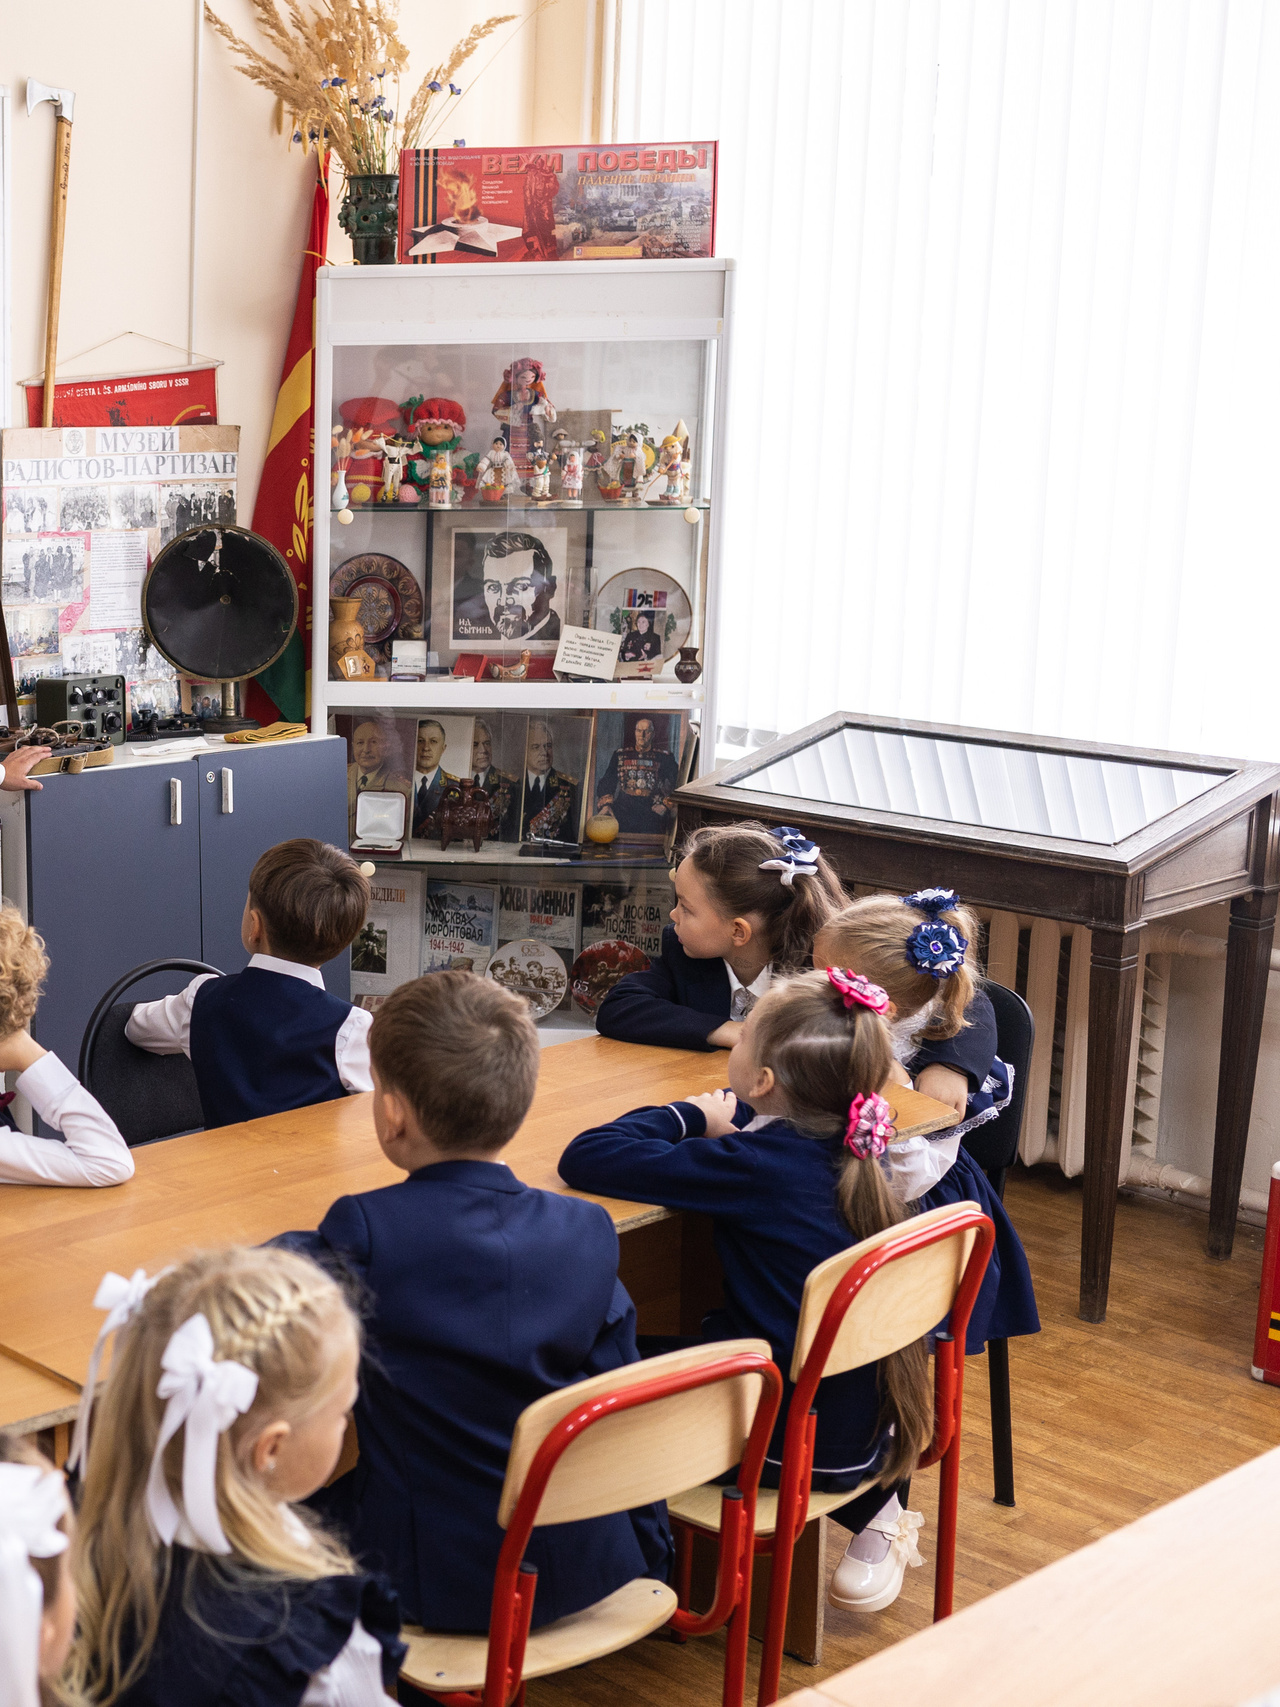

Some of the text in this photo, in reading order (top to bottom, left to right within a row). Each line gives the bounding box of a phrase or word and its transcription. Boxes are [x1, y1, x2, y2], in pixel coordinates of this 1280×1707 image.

[481, 149, 707, 175] ВЕХИ ПОБЕДЫ
[578, 173, 696, 185] ПАДЕНИЕ БЕРЛИНА
[114, 381, 147, 393] ARMÁDNÍHO
[148, 380, 167, 389] SBORU
[168, 379, 173, 388] V
[174, 378, 189, 387] SSSR
[101, 427, 175, 452] МУЗЕЙ
[4, 454, 235, 484] РАДИСТОВ-ПАРТИЗАН
[637, 594, 653, 608] 25
[459, 626, 493, 635] СЫТИНЪ
[370, 887, 405, 904] БЕДИЛИ
[530, 889, 575, 917] ВОЕННАЯ
[431, 909, 467, 925] МОСКВА
[529, 914, 553, 926] 1941/45
[624, 905, 660, 922] МОСКВА
[425, 922, 483, 941] ИФРОНТОВАЯ
[605, 918, 636, 934] ПОСЛЕ
[573, 980, 589, 992] 65
